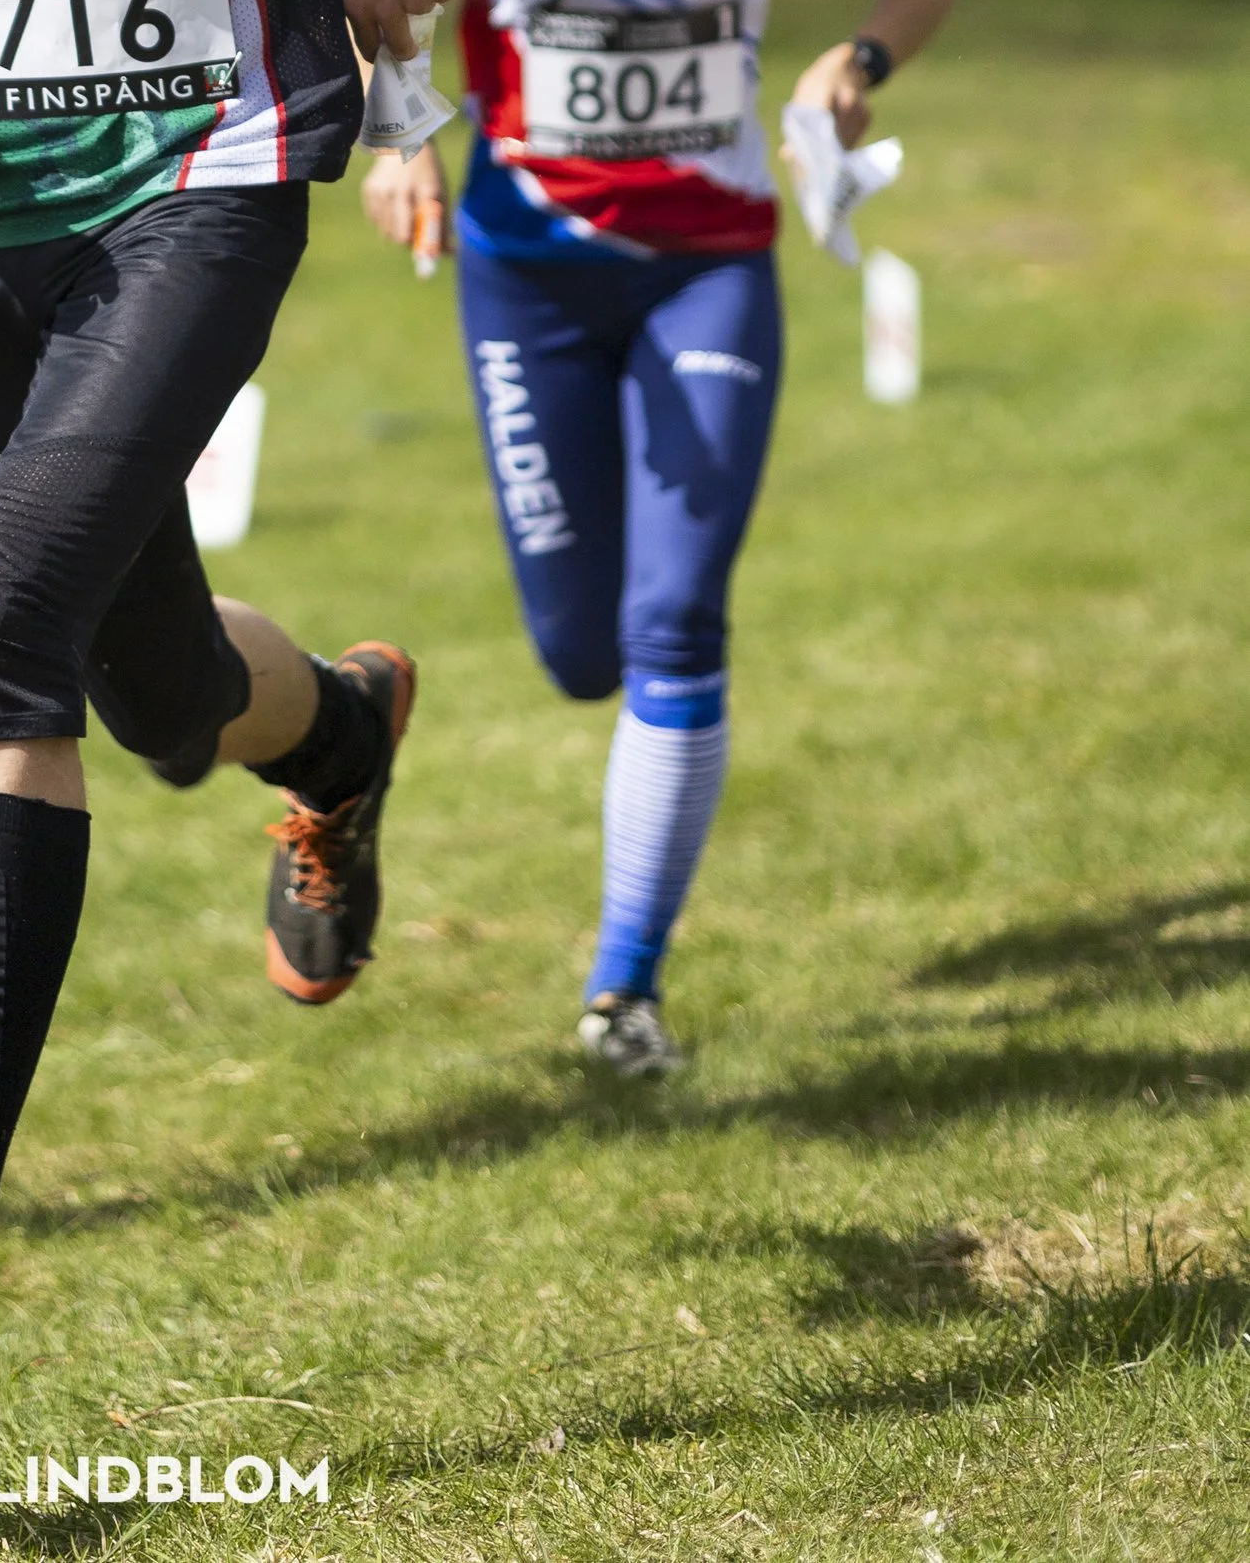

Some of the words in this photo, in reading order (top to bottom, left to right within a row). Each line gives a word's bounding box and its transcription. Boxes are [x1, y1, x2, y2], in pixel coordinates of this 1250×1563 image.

[6, 75, 193, 112] FINSPÅNG
[566, 55, 706, 124] 804
[475, 339, 579, 556] HALDEN
